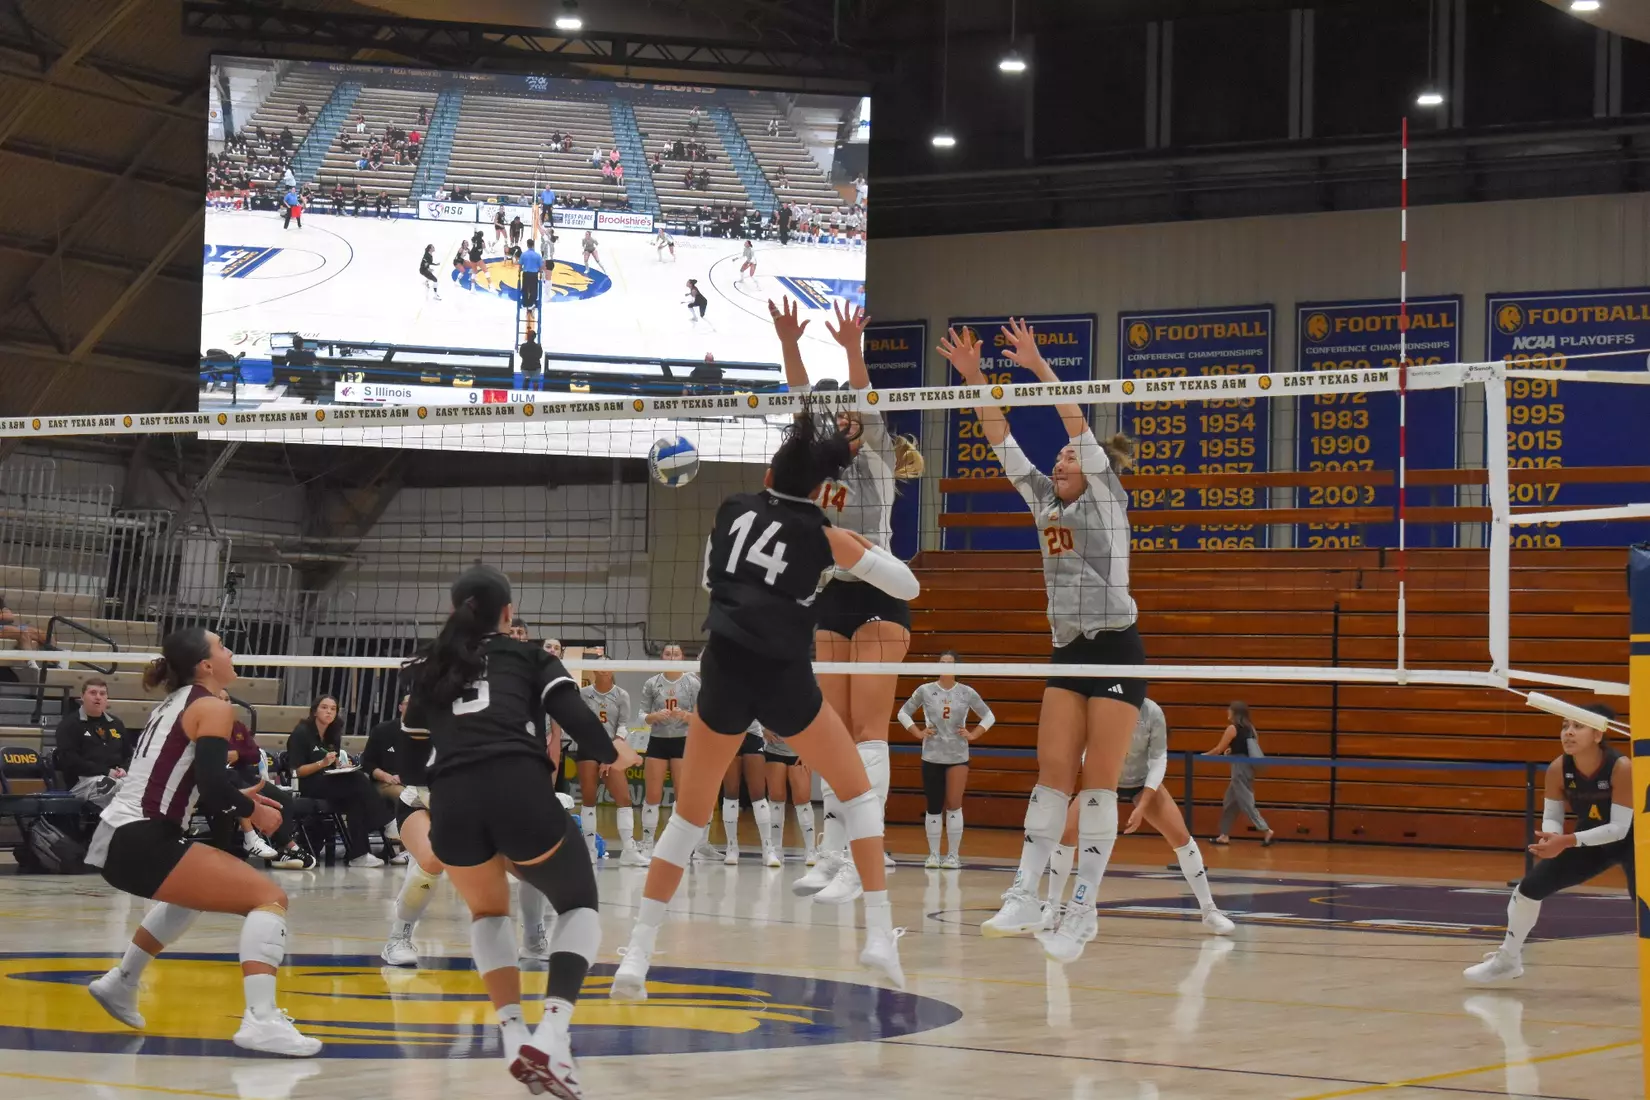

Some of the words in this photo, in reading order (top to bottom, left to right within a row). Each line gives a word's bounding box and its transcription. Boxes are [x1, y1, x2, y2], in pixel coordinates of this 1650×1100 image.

[443, 206, 464, 215] ASG
[598, 214, 652, 226] Brookshire's
[1528, 304, 1650, 324] FOOTBALL
[1335, 313, 1454, 332] FOOTALL
[1154, 322, 1267, 341] FOOTBALL
[994, 332, 1079, 347] SBALL
[1512, 335, 1556, 350] NCAA
[1560, 334, 1635, 346] PLAYOFFS
[1128, 352, 1185, 361] CONFERENCE
[1188, 348, 1263, 359] CHAMPIONSHIPS
[1306, 345, 1366, 354] CONFERENCE
[1370, 341, 1450, 352] CHAMIONSHIPS
[997, 357, 1083, 368] TOUMENT
[1382, 357, 1442, 368] 216
[1146, 382, 1175, 392] EAST
[1180, 380, 1217, 390] TEXAS
[1222, 378, 1246, 388] A&M
[1284, 376, 1314, 387] EAST
[1318, 374, 1358, 385] TEXAS
[1363, 372, 1389, 382] A&M
[364, 386, 372, 396] S
[376, 386, 412, 398] Illinois
[469, 392, 478, 404] 9
[511, 393, 536, 402] ULM
[889, 393, 916, 402] EAST
[920, 392, 954, 401] TEXAS
[958, 390, 980, 400] A&M
[1014, 387, 1043, 396] EAST
[1047, 386, 1082, 395] TEXAS
[1088, 384, 1110, 394] A&M
[1505, 379, 1558, 399] 1991
[653, 401, 680, 410] EAST
[684, 400, 714, 409] TEXAS
[717, 398, 738, 408] A&M
[768, 396, 795, 406] EAST
[834, 394, 857, 404] A&M
[334, 410, 355, 419] EAST
[360, 410, 387, 418] TEXAS
[390, 408, 409, 418] A&M
[436, 408, 460, 416] EAST
[464, 407, 492, 416] TEXAS
[496, 406, 514, 415] A&M
[543, 404, 567, 414] EAST
[570, 403, 600, 412] TEXAS
[604, 402, 624, 411] A&M
[1506, 404, 1565, 425] 1995
[48, 420, 68, 428] EAST
[71, 419, 97, 427] TEXAS
[98, 418, 116, 426] A&M
[140, 417, 161, 426] EAST
[163, 416, 190, 425] TEXAS
[193, 415, 210, 424] A&M
[236, 414, 258, 423] EAST
[260, 413, 286, 422] TEXAS
[290, 412, 308, 421] A&M
[1132, 415, 1187, 435] 1935
[1199, 413, 1256, 433] 1954
[1311, 410, 1369, 430] 1983
[9, 421, 25, 429] A&M
[958, 420, 986, 439] 20
[1311, 434, 1370, 455] 1990
[1506, 430, 1563, 450] 2015
[958, 444, 1000, 461] 202
[1132, 440, 1186, 460] 1937
[1199, 438, 1256, 458] 1955
[957, 467, 1006, 478] 202
[1310, 460, 1374, 472] 2007
[822, 483, 848, 512] 14
[1198, 487, 1255, 507] 1958
[726, 510, 788, 586] 14
[1044, 526, 1074, 556] 20
[1198, 536, 1255, 550] 1966
[665, 698, 678, 711] 10
[599, 711, 608, 724] 5
[942, 706, 951, 720] 2
[4, 753, 38, 764] LIONS
